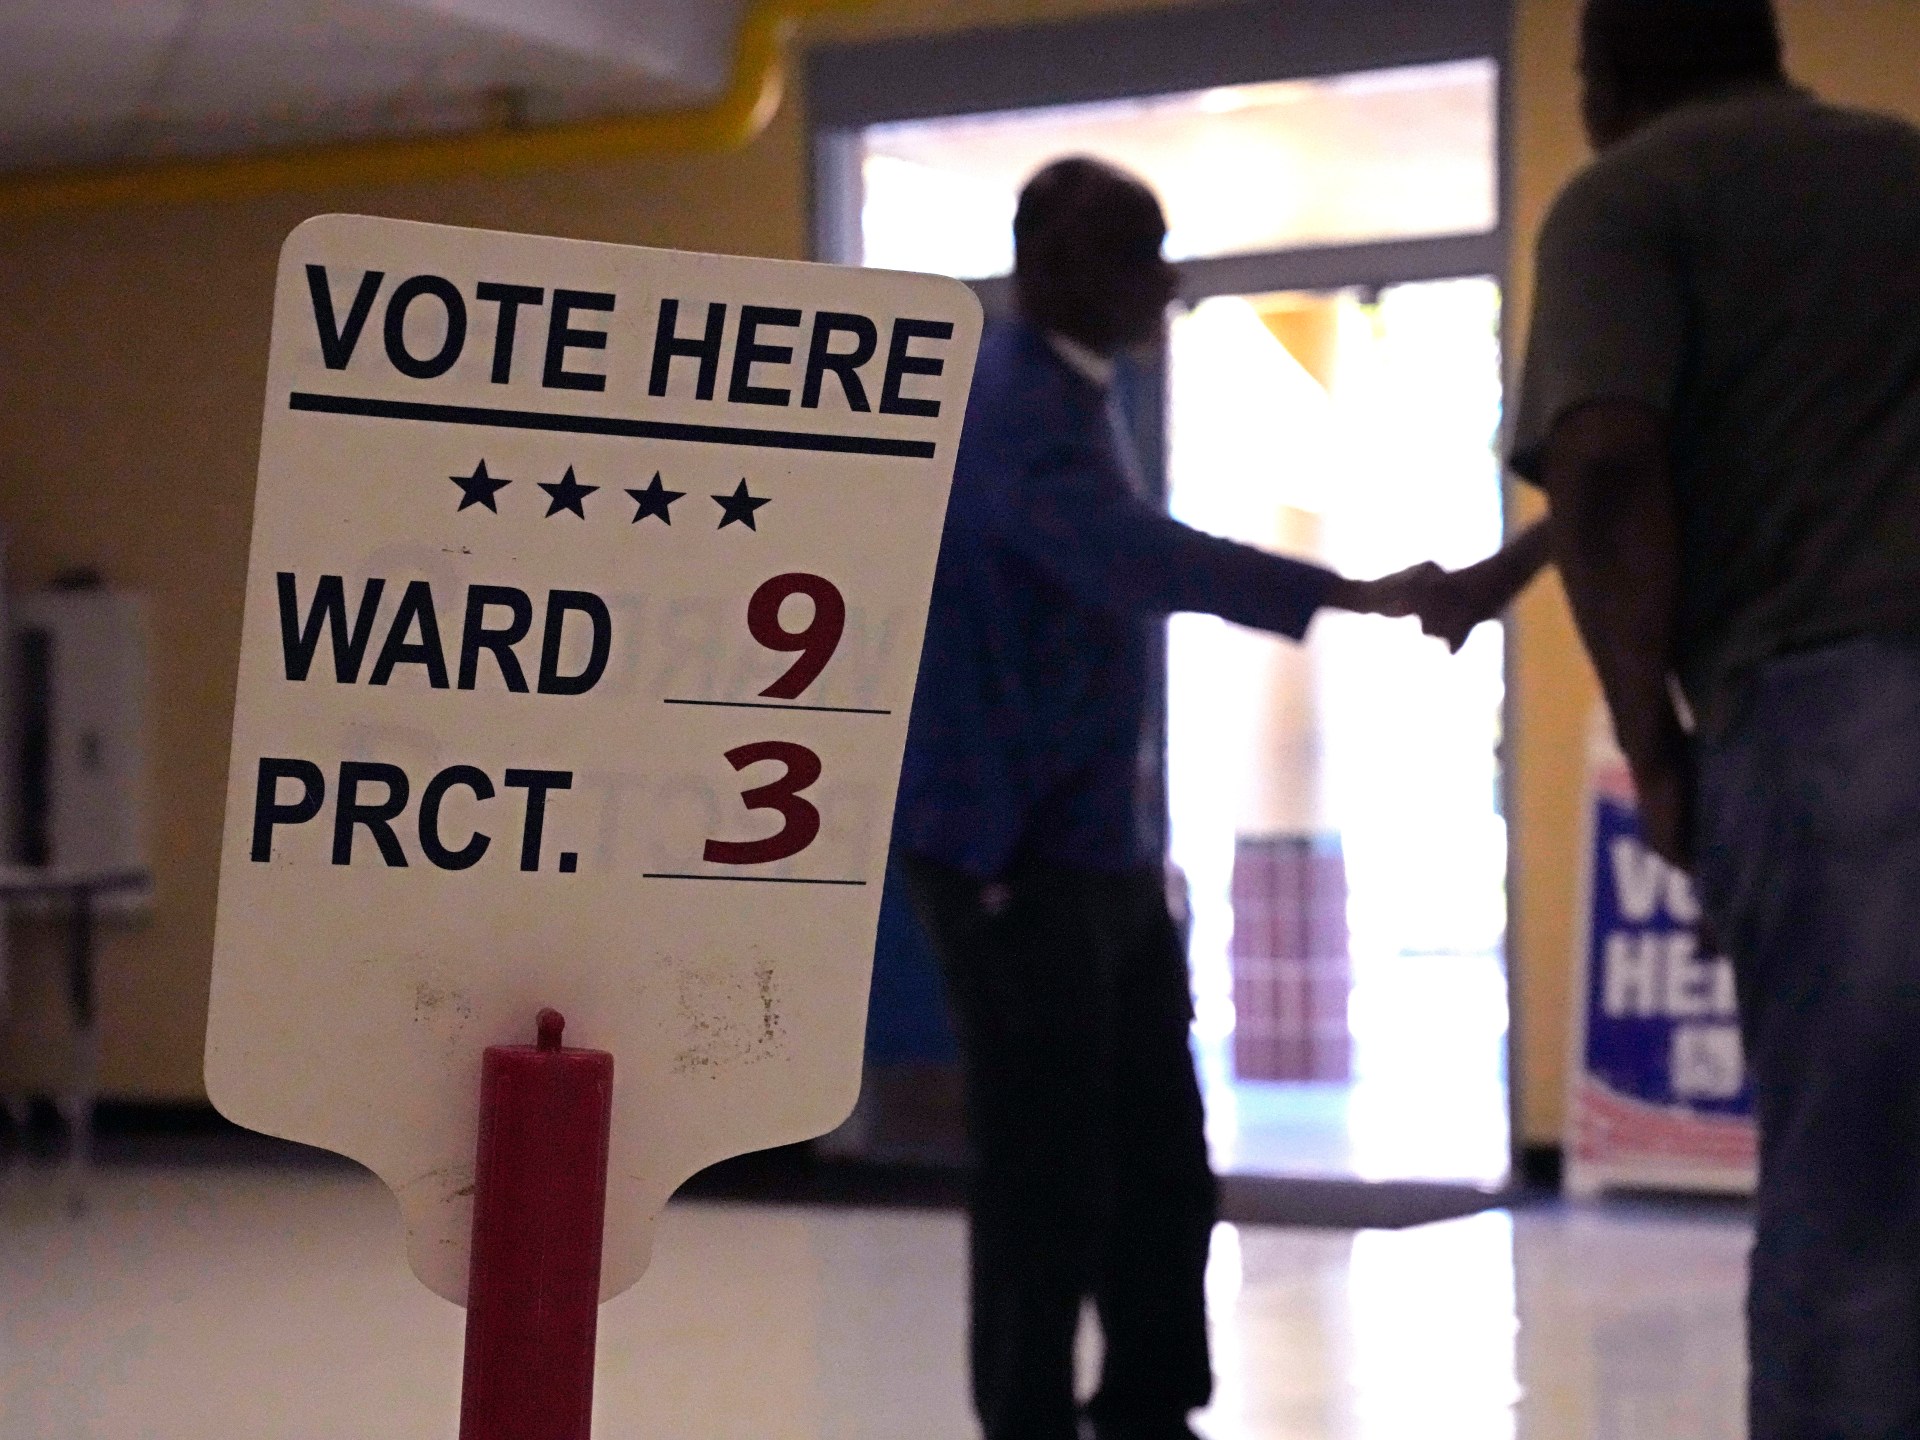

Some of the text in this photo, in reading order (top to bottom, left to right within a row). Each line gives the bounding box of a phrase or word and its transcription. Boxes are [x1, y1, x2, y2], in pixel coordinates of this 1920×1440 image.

[305, 263, 954, 418] VOTE HERE
[276, 571, 612, 696] WARD
[747, 572, 846, 700] 9
[250, 756, 578, 874] PRCT.
[702, 740, 822, 865] 3
